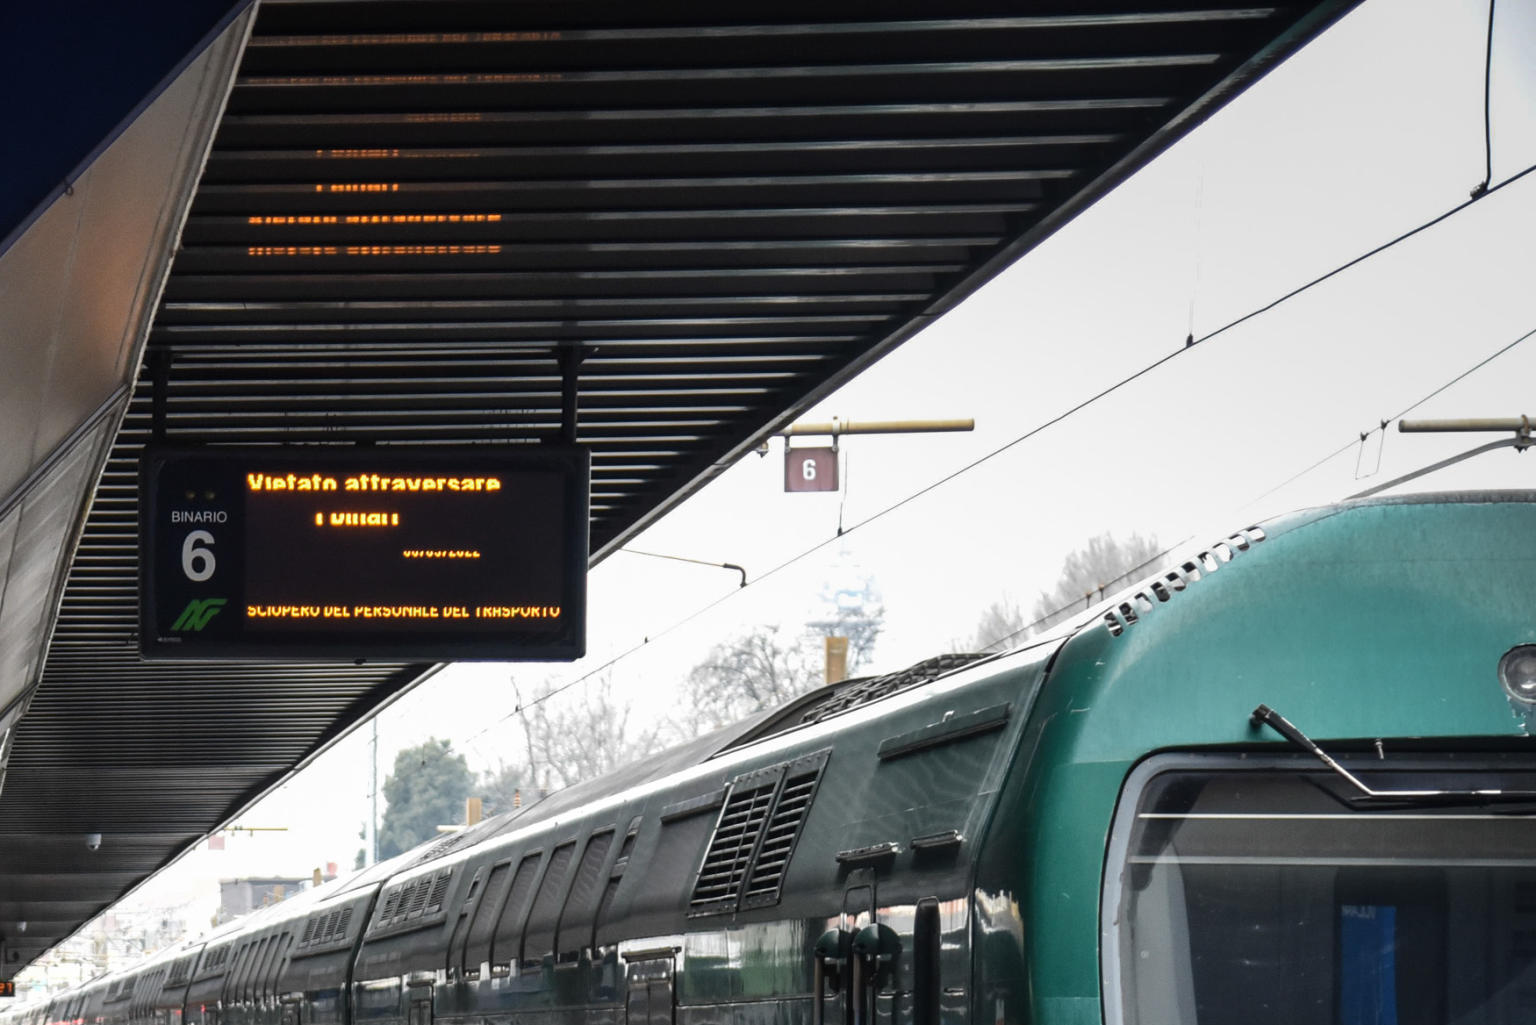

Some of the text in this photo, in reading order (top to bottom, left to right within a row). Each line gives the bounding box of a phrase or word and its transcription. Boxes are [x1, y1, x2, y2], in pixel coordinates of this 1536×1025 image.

[802, 459, 816, 480] 6
[171, 511, 227, 523] BINARIO
[182, 530, 216, 582] 6
